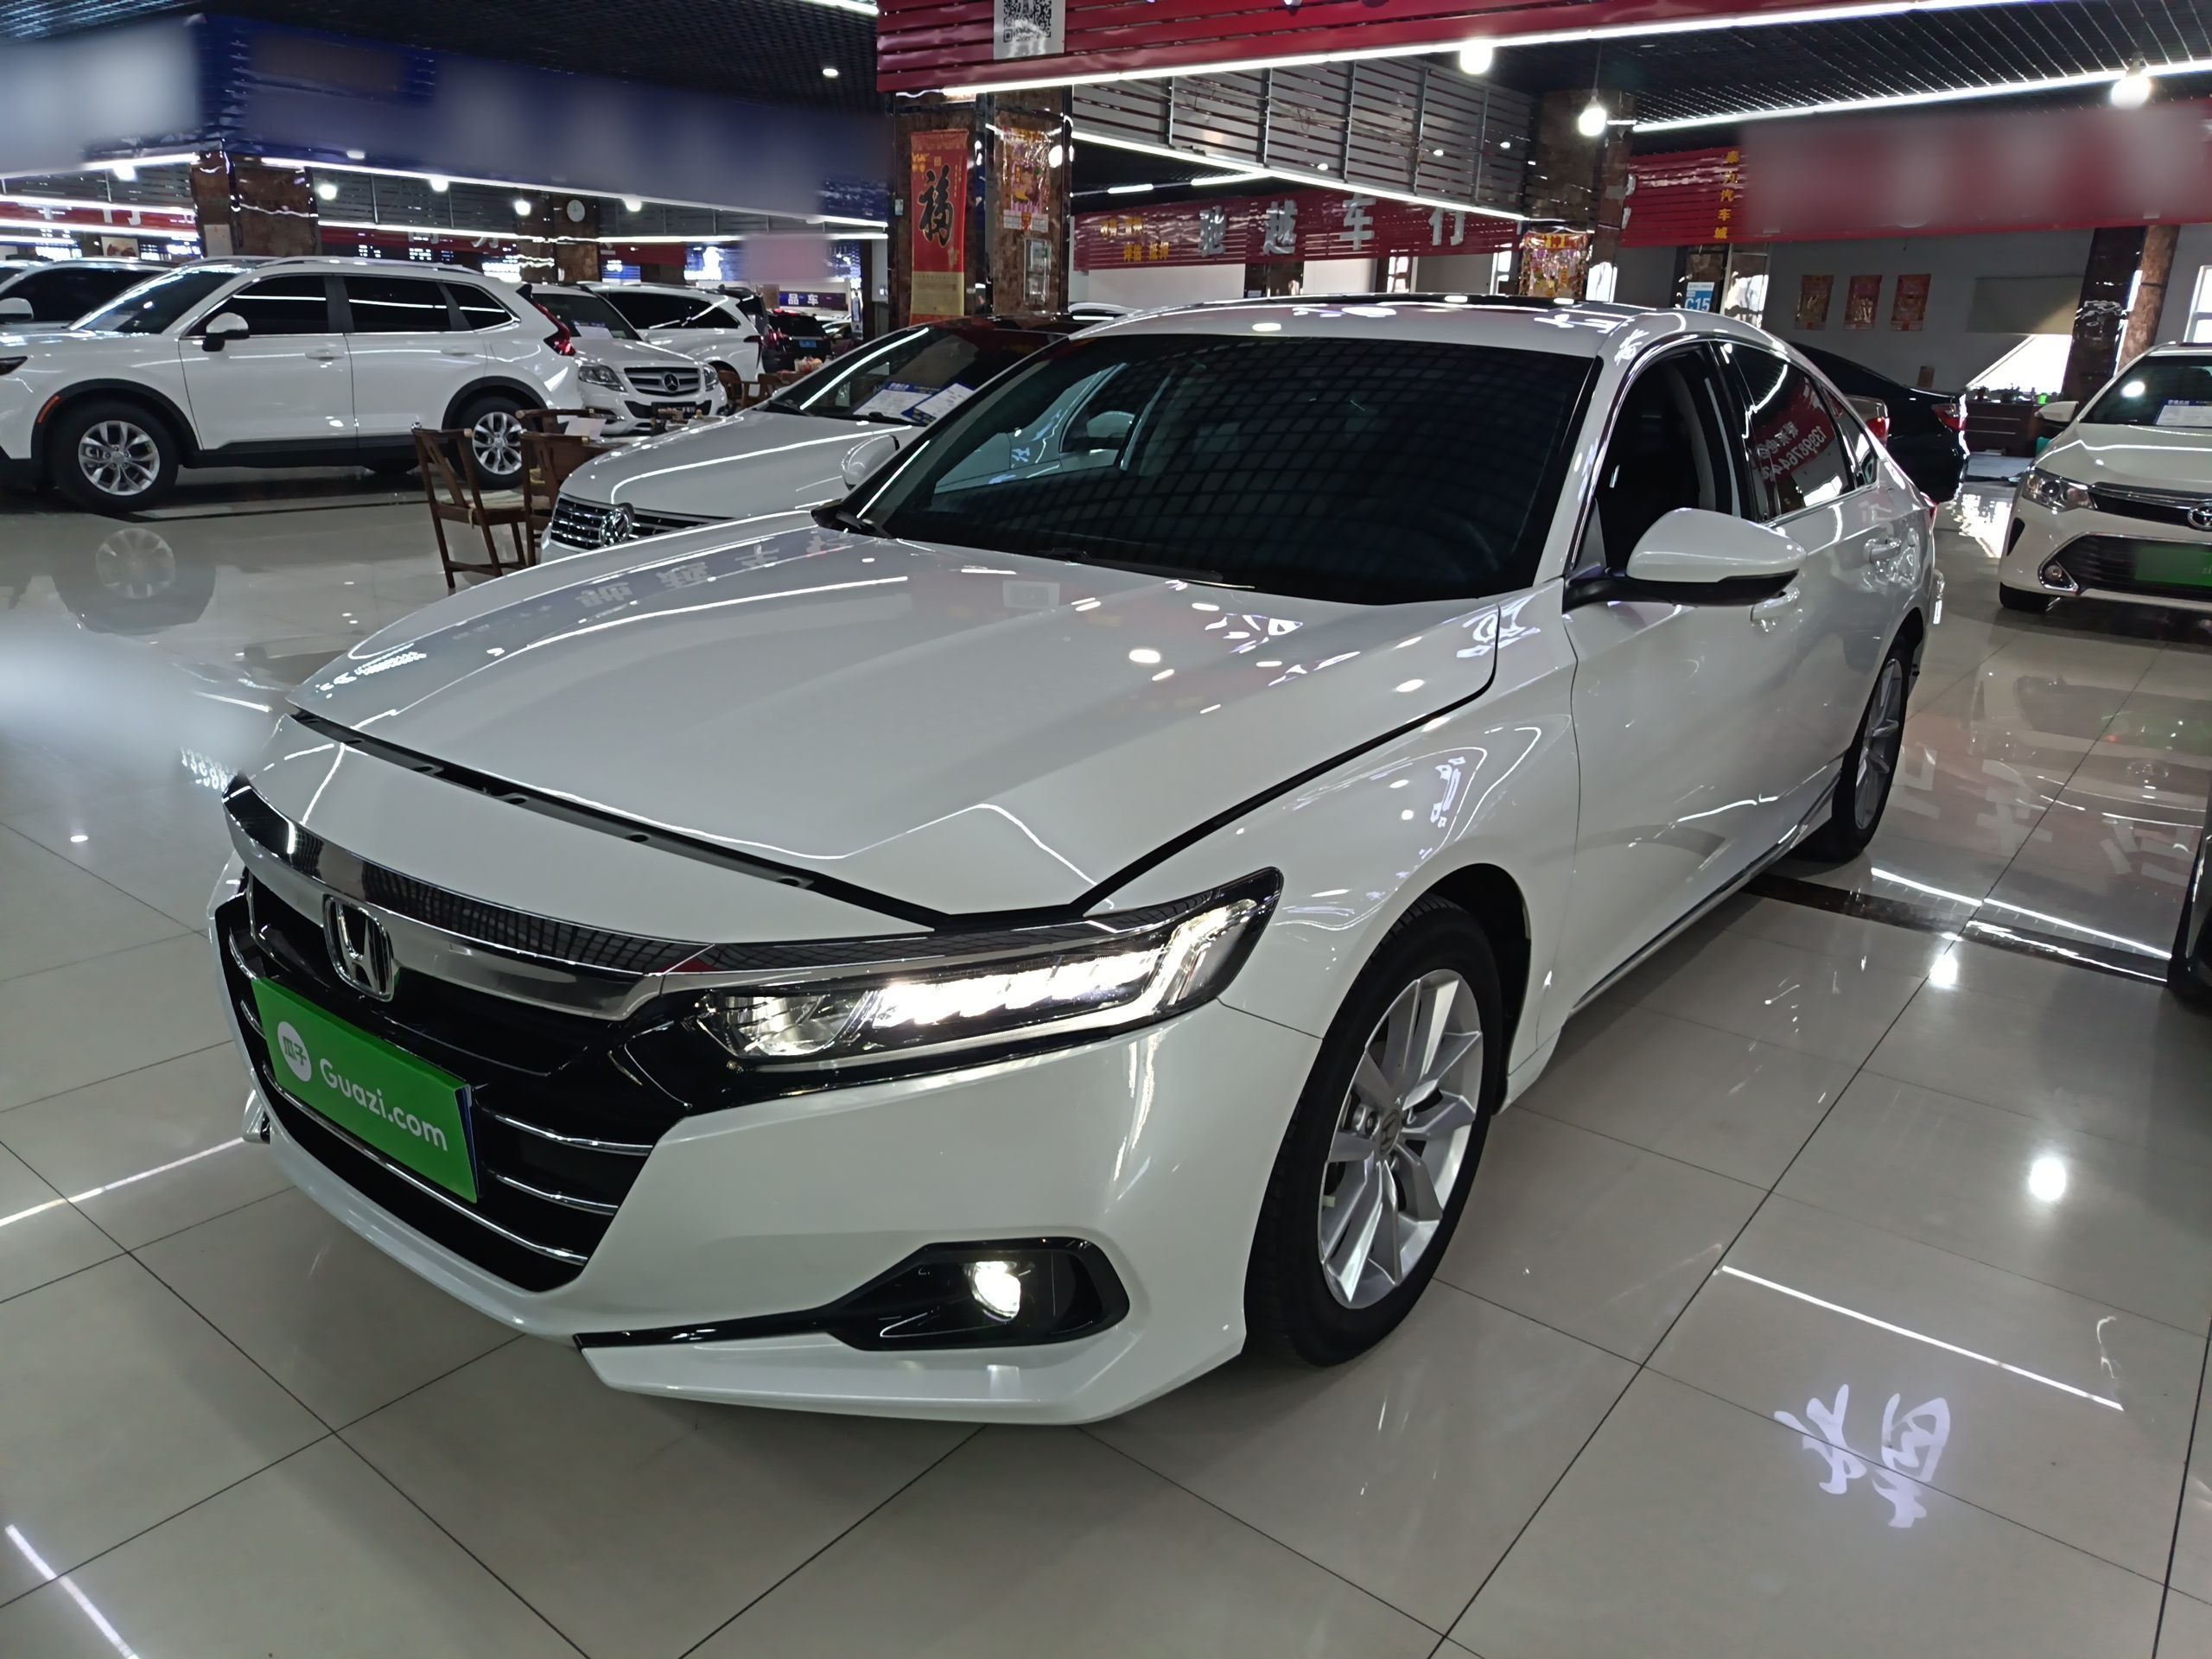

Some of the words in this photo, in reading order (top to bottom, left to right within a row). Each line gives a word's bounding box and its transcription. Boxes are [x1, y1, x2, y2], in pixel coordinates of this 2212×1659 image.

[917, 164, 955, 249] 福
[1684, 297, 1711, 312] C15
[282, 1035, 307, 1066] 瓜子
[319, 1058, 448, 1152] Guazi.com
